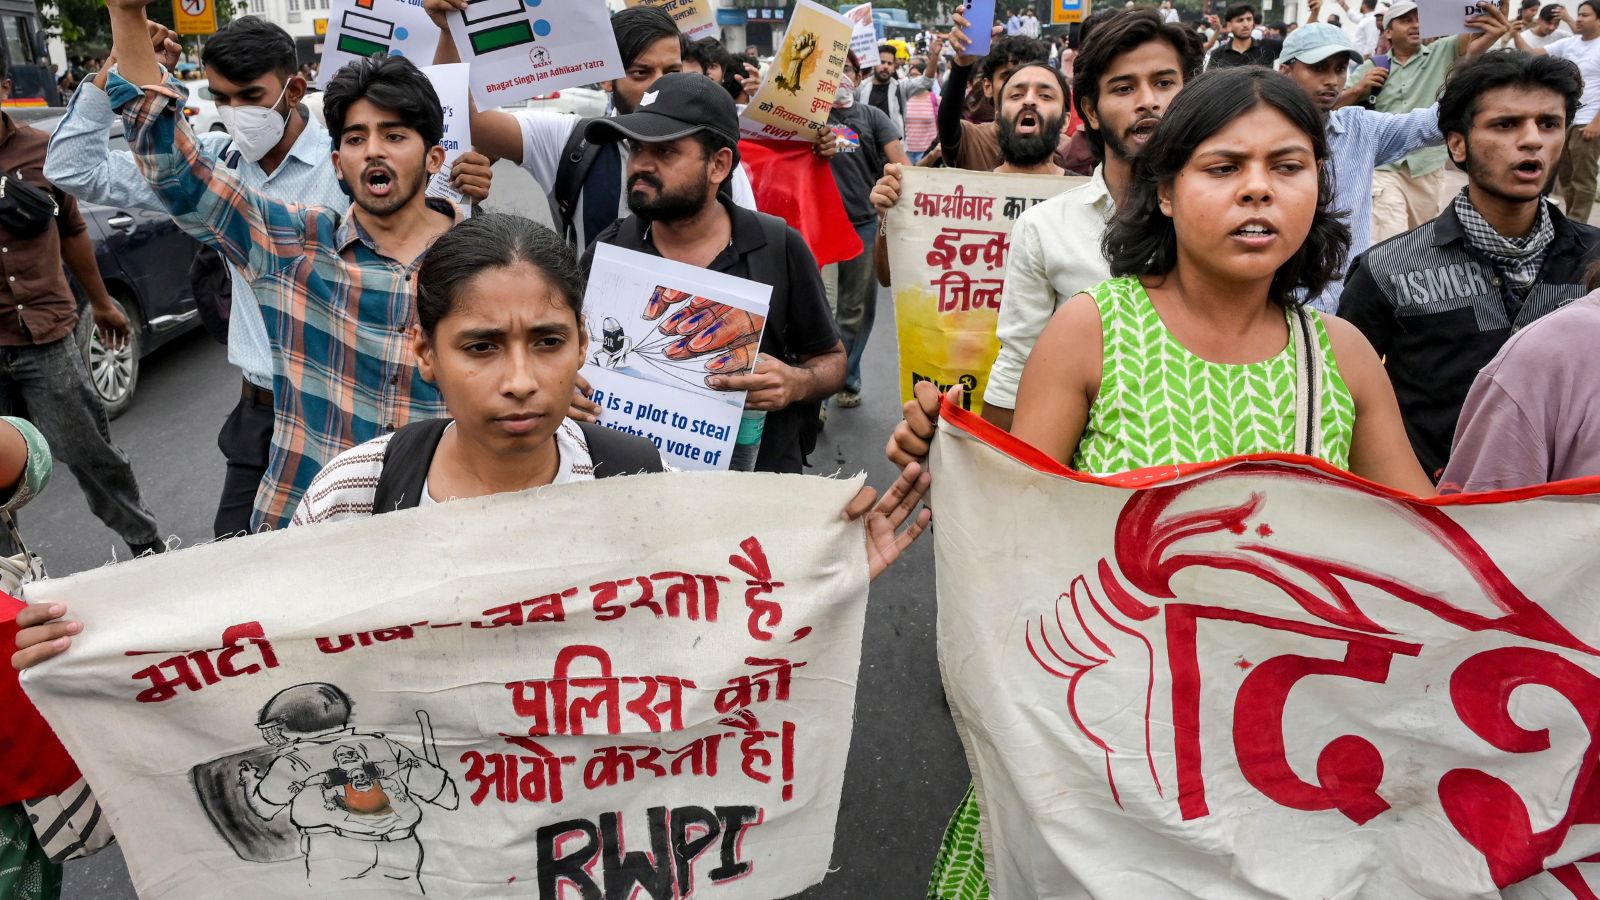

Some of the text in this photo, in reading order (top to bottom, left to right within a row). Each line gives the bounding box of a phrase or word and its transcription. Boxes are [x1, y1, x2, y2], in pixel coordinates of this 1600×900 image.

[486, 60, 605, 93] Bhagat Singh Jan Adhikaar Yatra
[758, 102, 774, 113] को
[1389, 261, 1488, 307] USMCR
[606, 392, 621, 411] is
[623, 400, 633, 415] a
[635, 404, 669, 425] plot
[671, 411, 688, 430] to
[690, 419, 731, 442] steal
[666, 439, 700, 460] vote
[703, 449, 722, 467] of
[590, 571, 731, 623] डरता
[714, 656, 808, 714] को
[460, 732, 576, 806] आगे
[583, 732, 737, 790] करता
[536, 805, 764, 900] RWPI
